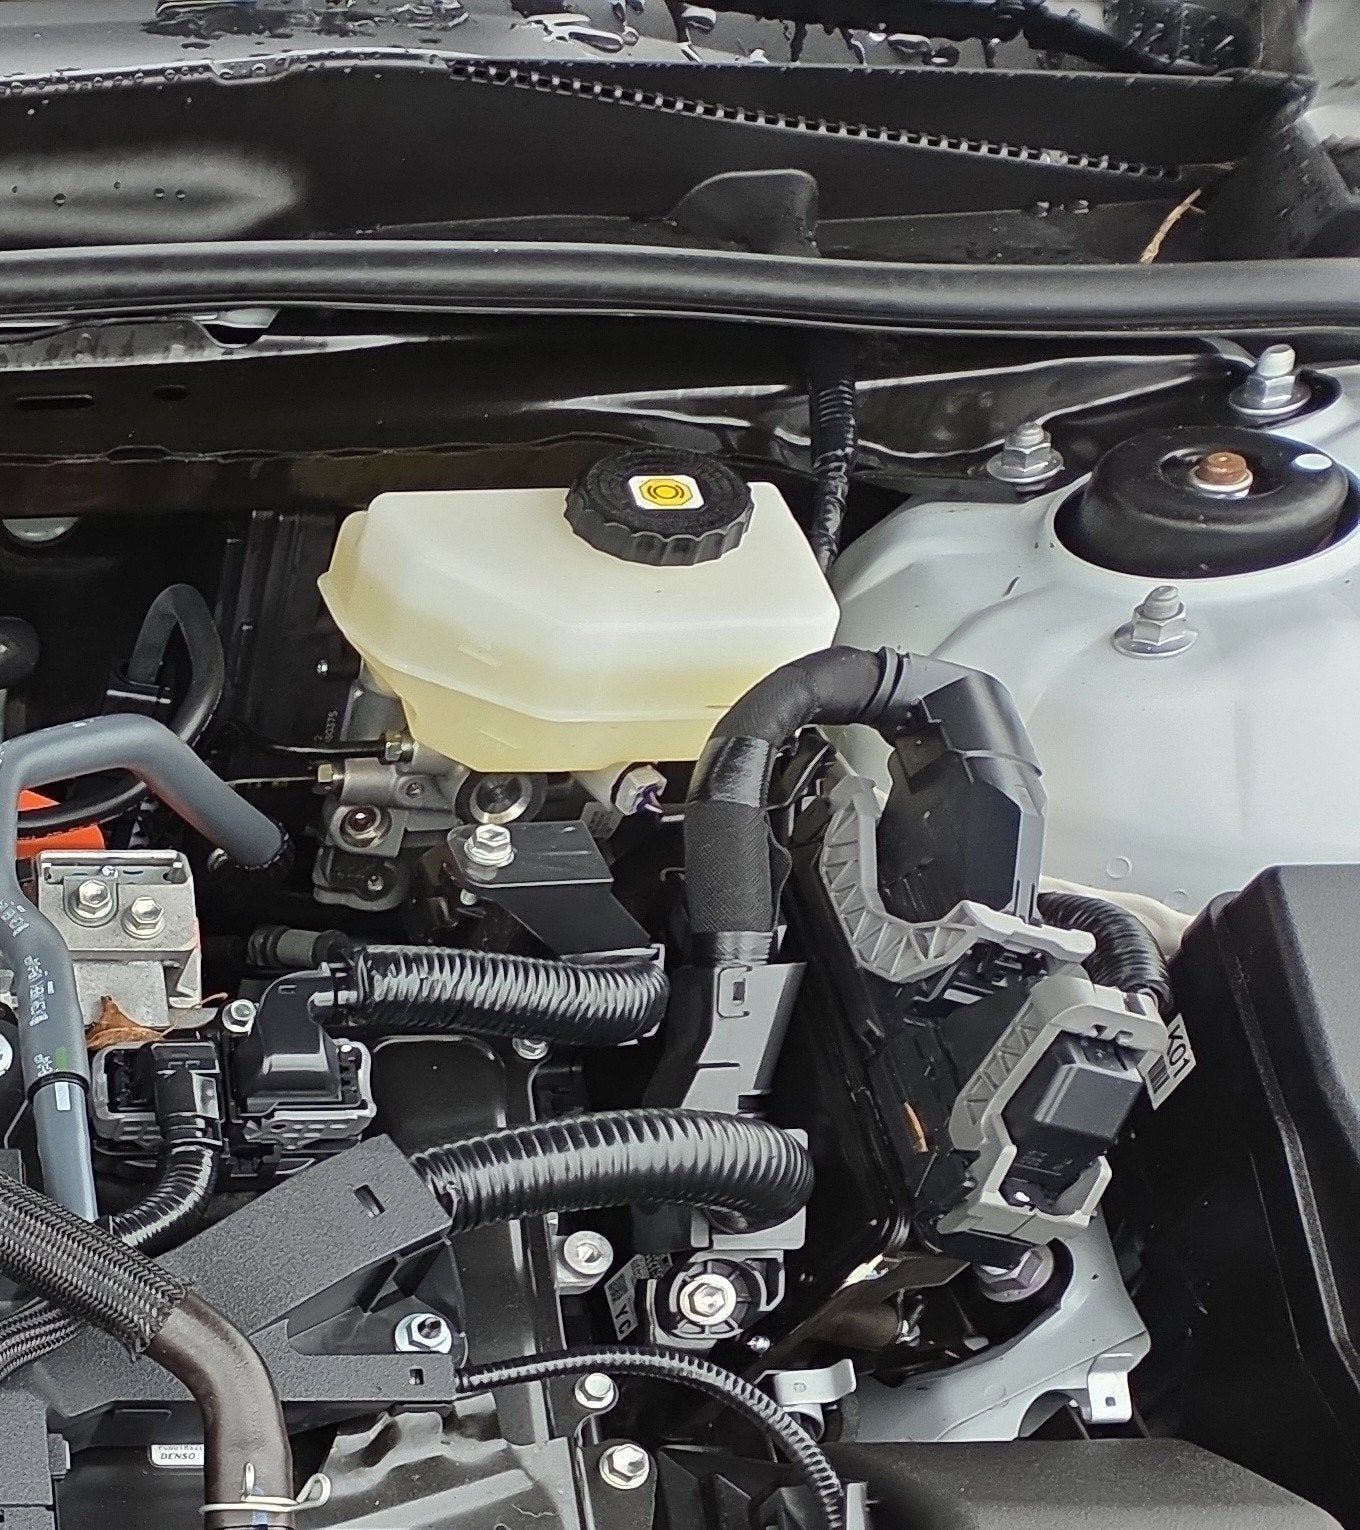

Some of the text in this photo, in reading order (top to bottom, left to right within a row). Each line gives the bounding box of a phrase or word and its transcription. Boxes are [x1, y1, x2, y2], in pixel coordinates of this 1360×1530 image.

[1166, 1023, 1192, 1079] K01
[615, 1302, 632, 1335] YC
[160, 1452, 196, 1460] DENSO
